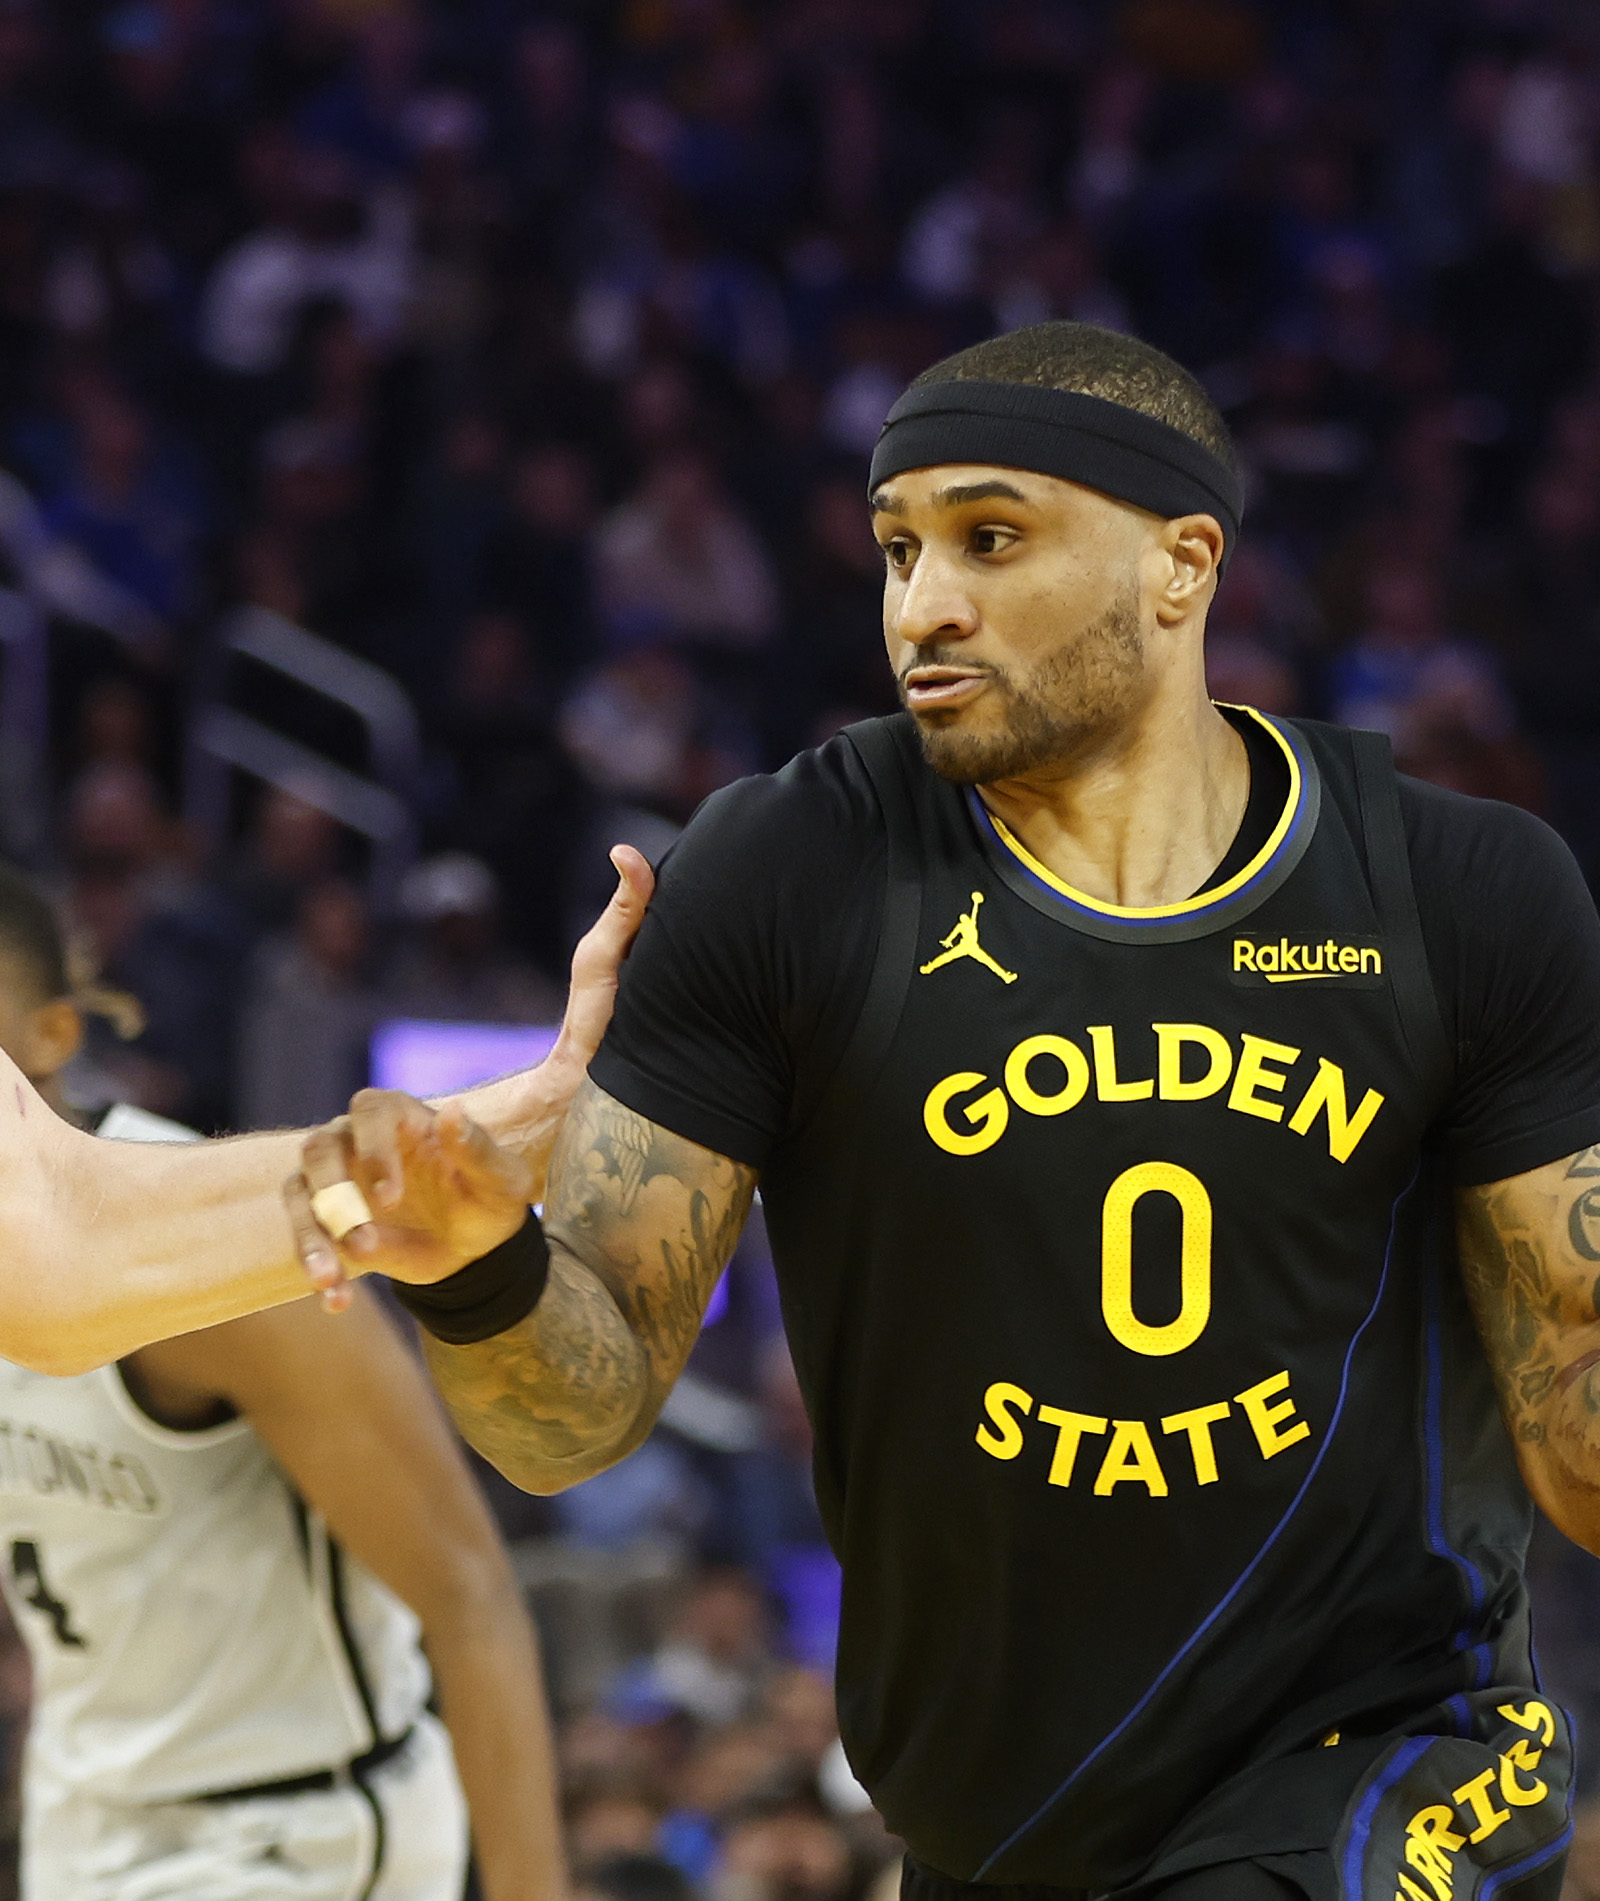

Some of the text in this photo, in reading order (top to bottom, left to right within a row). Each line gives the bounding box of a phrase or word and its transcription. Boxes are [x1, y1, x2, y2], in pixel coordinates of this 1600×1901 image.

[1233, 939, 1382, 976] Rakuten
[923, 1023, 1385, 1164] GOLDEN
[1102, 1161, 1213, 1356] 0
[975, 1370, 1310, 1497] STATE
